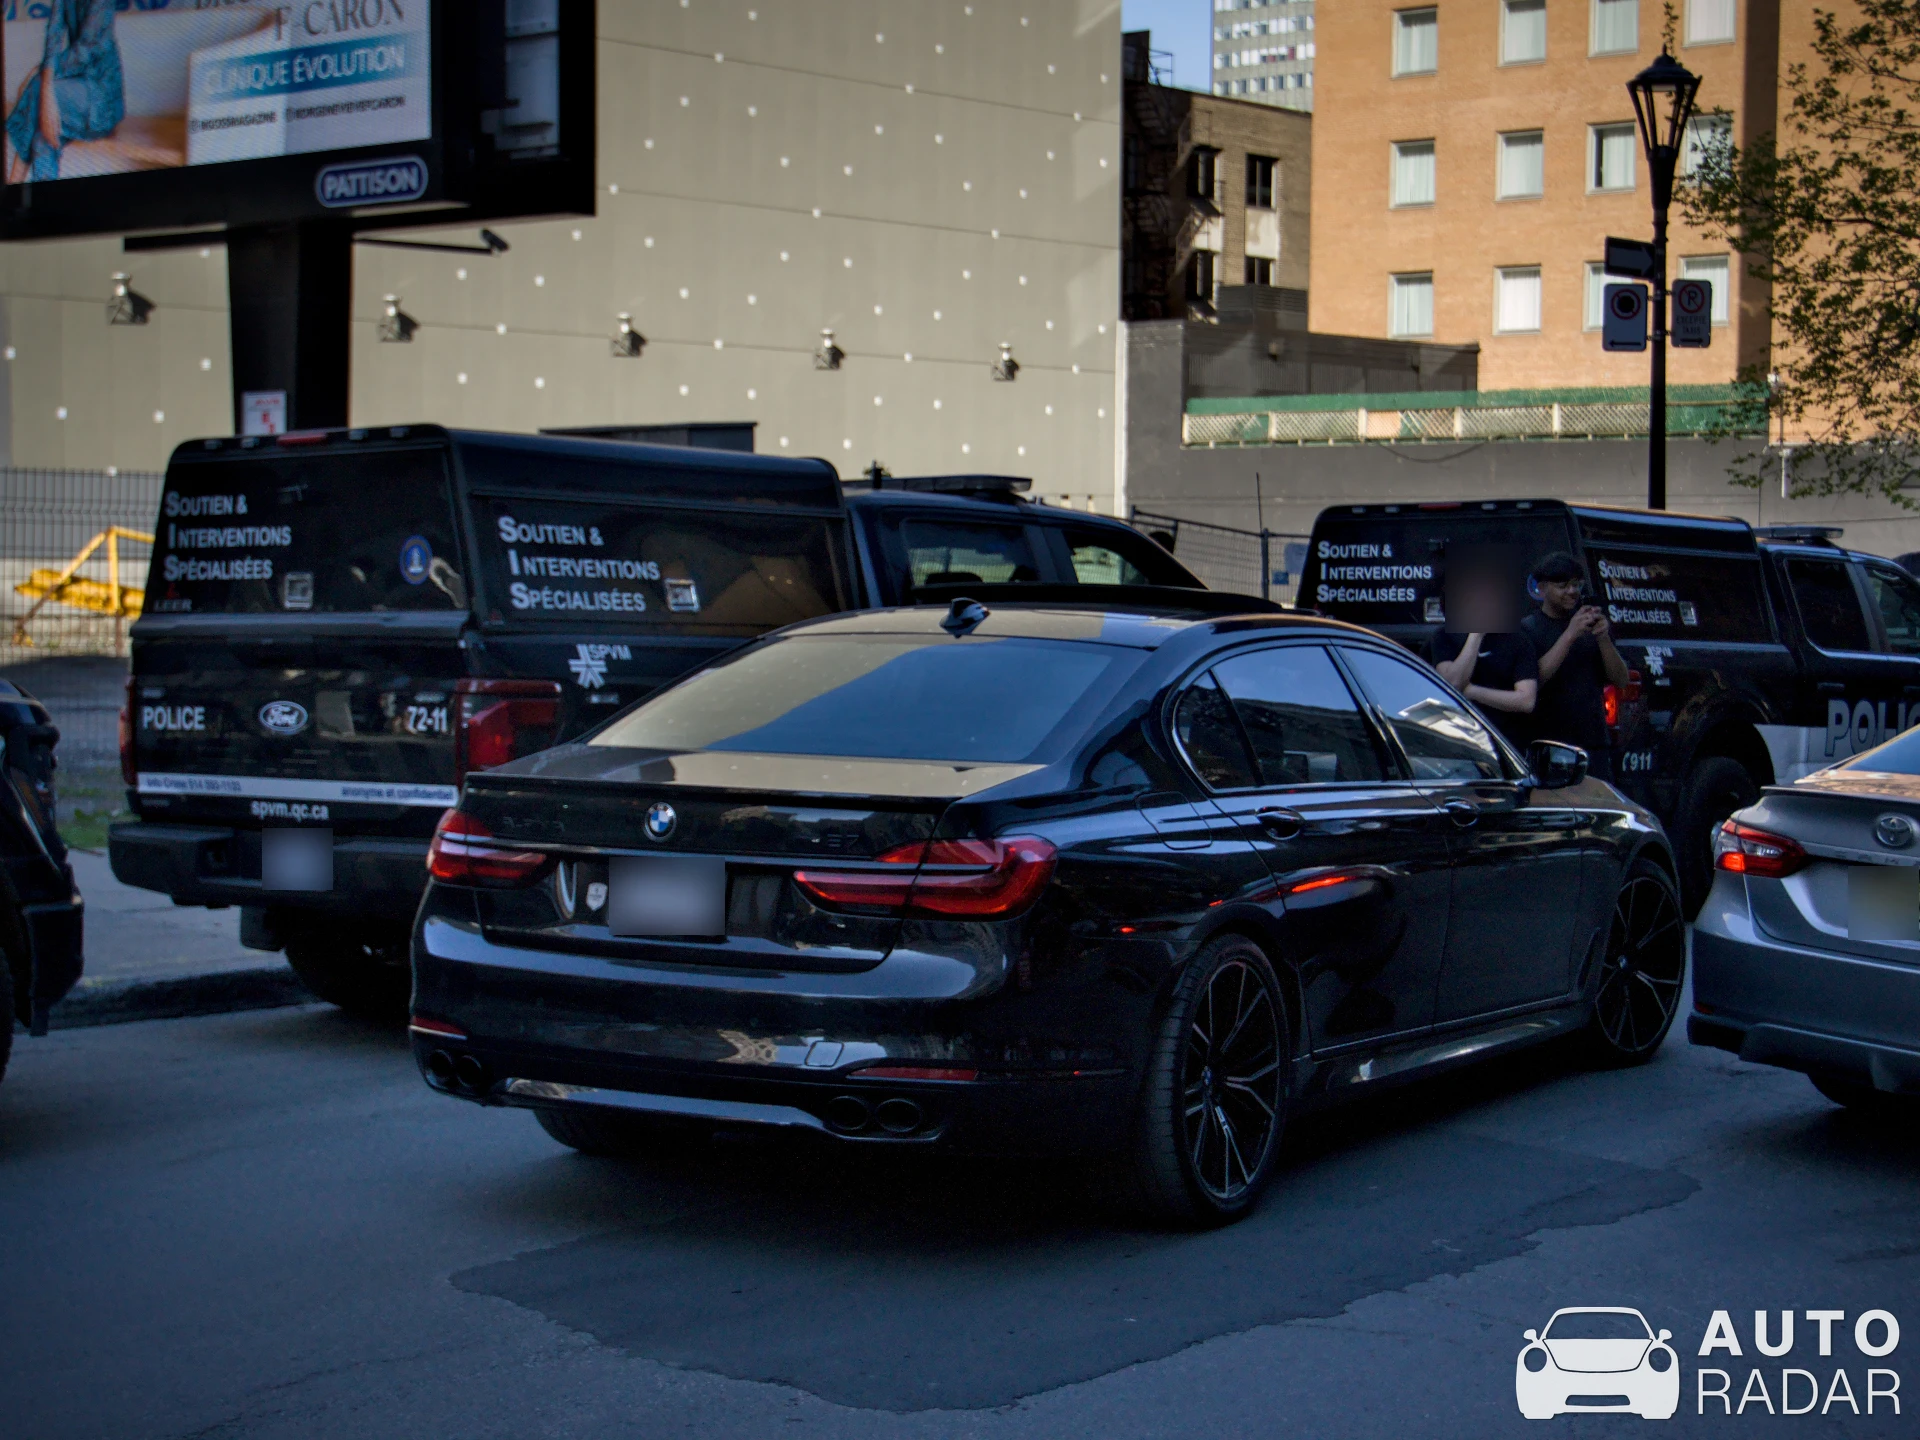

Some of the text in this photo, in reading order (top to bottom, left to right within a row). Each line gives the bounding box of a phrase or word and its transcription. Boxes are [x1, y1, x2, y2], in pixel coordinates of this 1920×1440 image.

[292, 44, 405, 83] ÉVOLUTION
[323, 168, 418, 199] PATTISON
[165, 491, 248, 517] SOUTIEN &
[168, 523, 292, 548] INTERVENTIONS
[498, 516, 604, 546] SOUTIEN &
[1317, 541, 1392, 559] SOUTIEN &
[164, 554, 273, 581] SPÉCIALISÉES
[508, 549, 661, 581] INTERVENTIONS
[1320, 563, 1432, 580] INTERVENTIONS
[1598, 560, 1638, 580] SOUTIEN
[510, 582, 646, 612] SPÉCIALISÉES
[1316, 584, 1416, 602] SPÉCIALISÉES
[1605, 583, 1676, 602] INTERVENTIONS
[1608, 604, 1672, 625] SPÉCIALISÉES
[142, 706, 206, 731] POLICE
[407, 706, 448, 732] 72-11
[1825, 698, 1920, 756] POLI
[1630, 752, 1652, 771] 911
[252, 800, 329, 822] spvm.qc.ca
